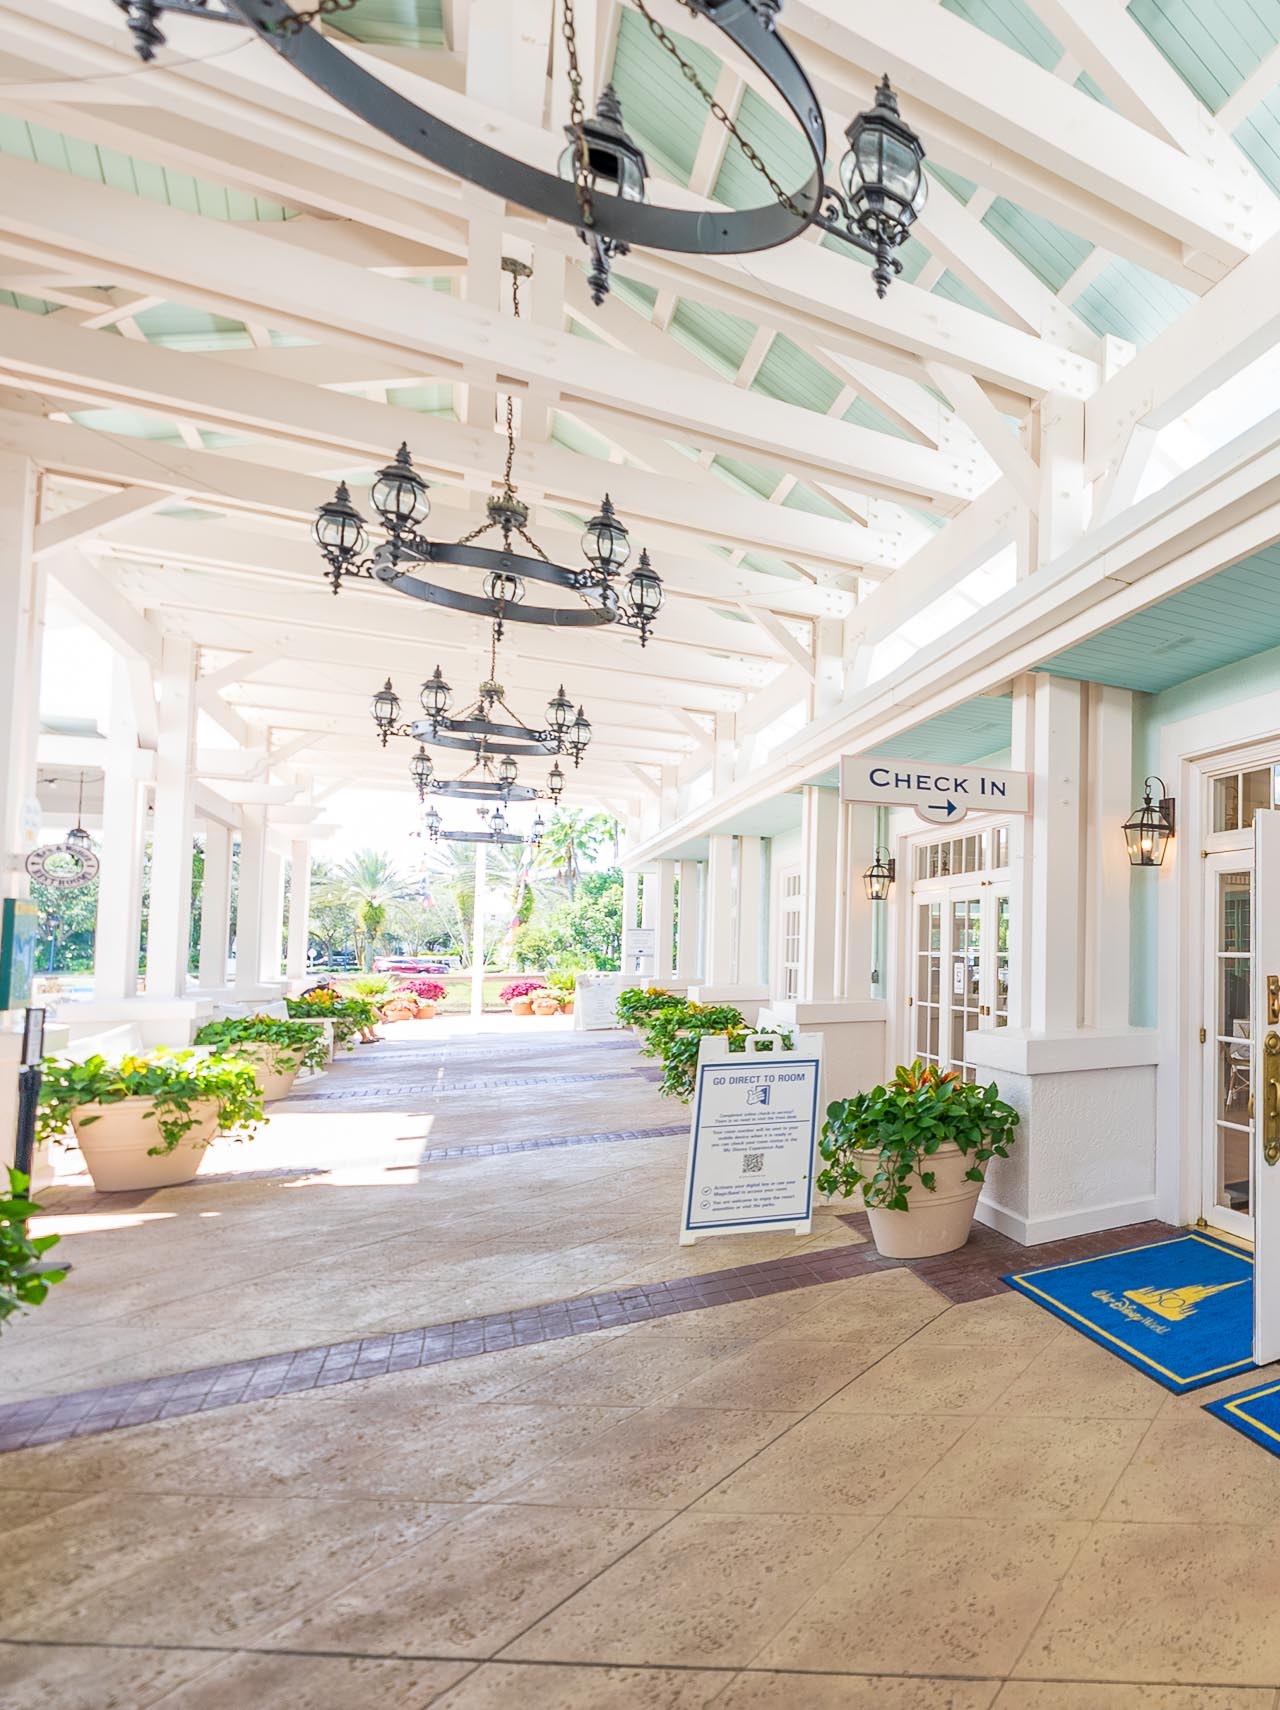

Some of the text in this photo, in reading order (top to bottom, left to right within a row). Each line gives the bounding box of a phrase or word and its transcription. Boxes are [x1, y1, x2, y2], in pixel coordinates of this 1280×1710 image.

[869, 767, 1007, 797] CHECK IN
[713, 1073, 805, 1086] GO DIRECT TO ROOM
